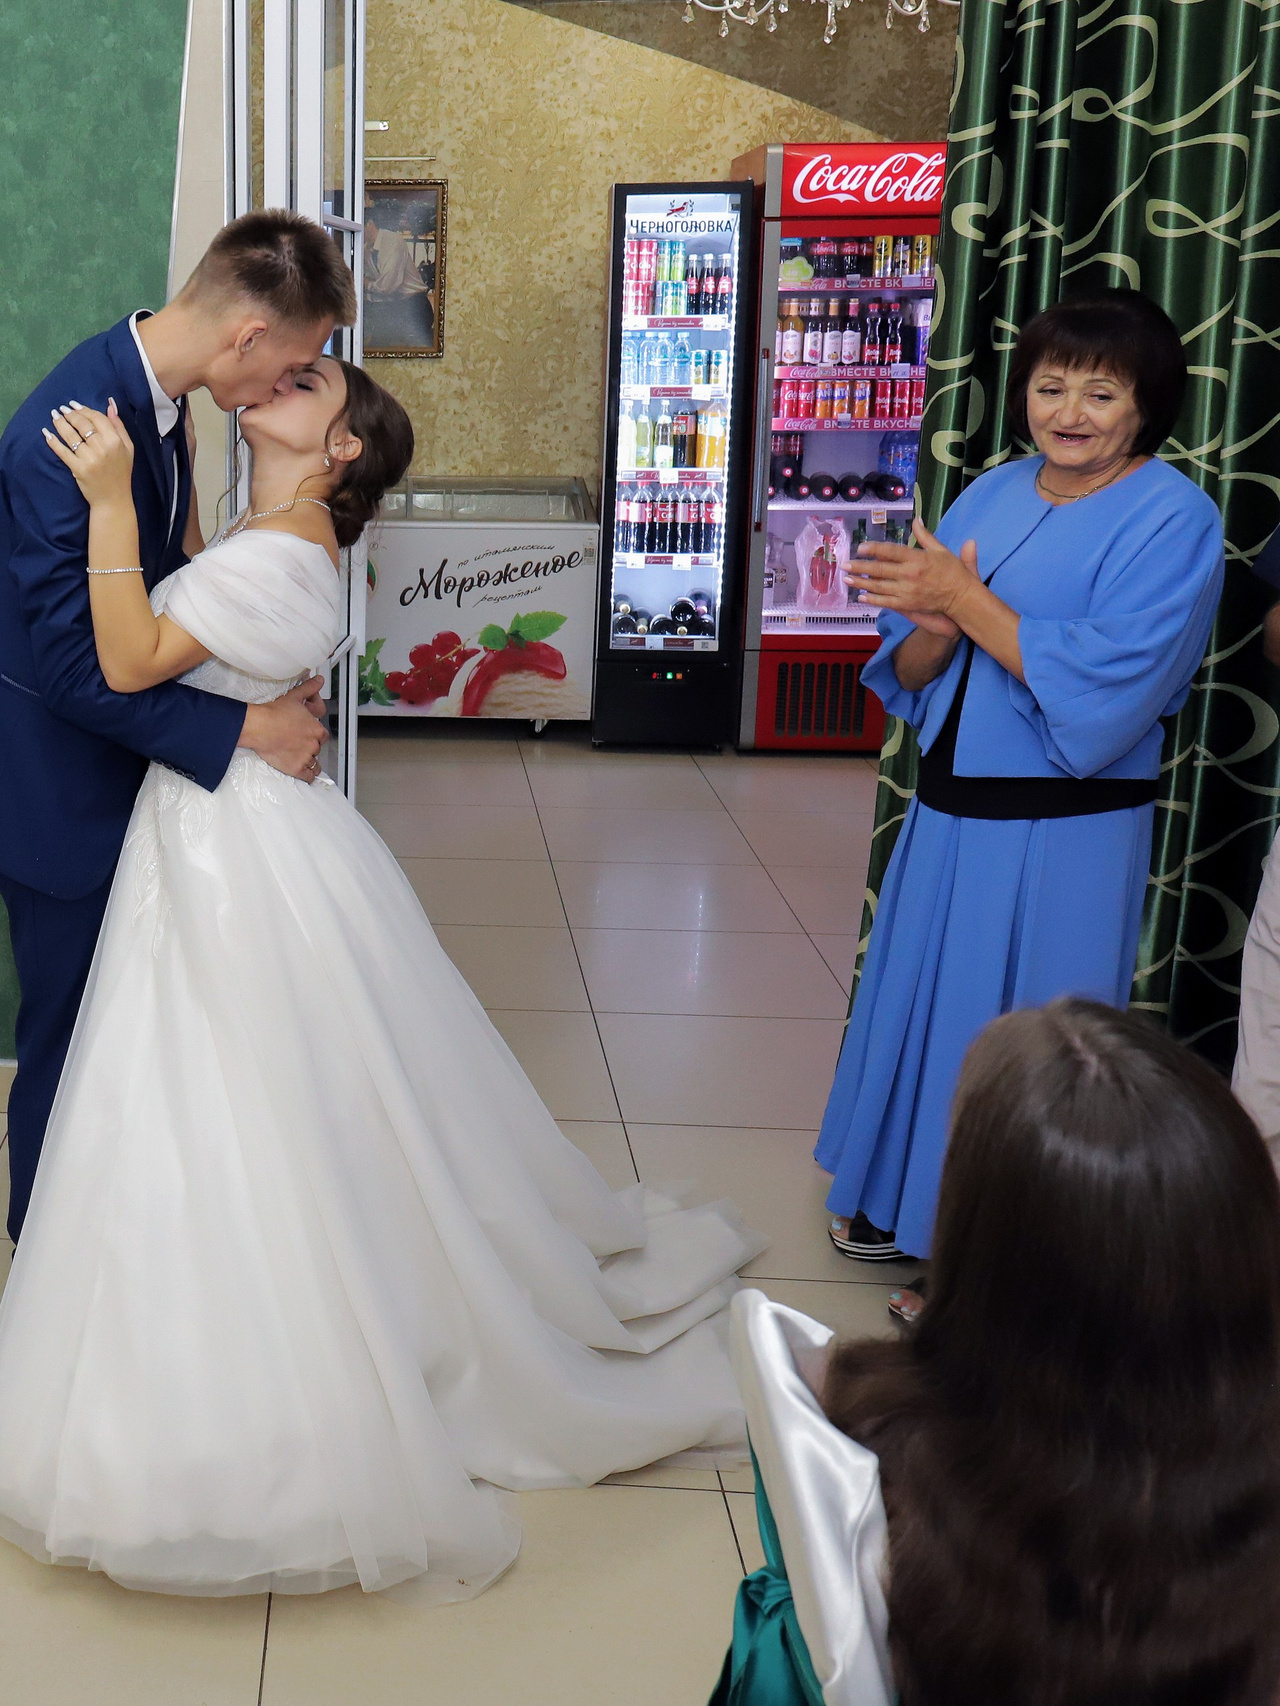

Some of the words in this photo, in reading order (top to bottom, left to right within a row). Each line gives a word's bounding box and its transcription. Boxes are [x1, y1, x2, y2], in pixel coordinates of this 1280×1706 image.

[792, 152, 946, 204] Coca-Cola
[630, 219, 733, 234] ЧЕРНОГОЛОВКА
[835, 278, 881, 288] ВМСТЕ
[789, 367, 820, 378] Coca-Col
[832, 367, 876, 377] ВМЕСТЕ
[824, 419, 870, 429] ВМСТЕ
[873, 419, 911, 429] ВКУСН
[457, 559, 469, 569] по
[399, 550, 583, 608] Мороженое
[472, 584, 543, 608] рецептам
